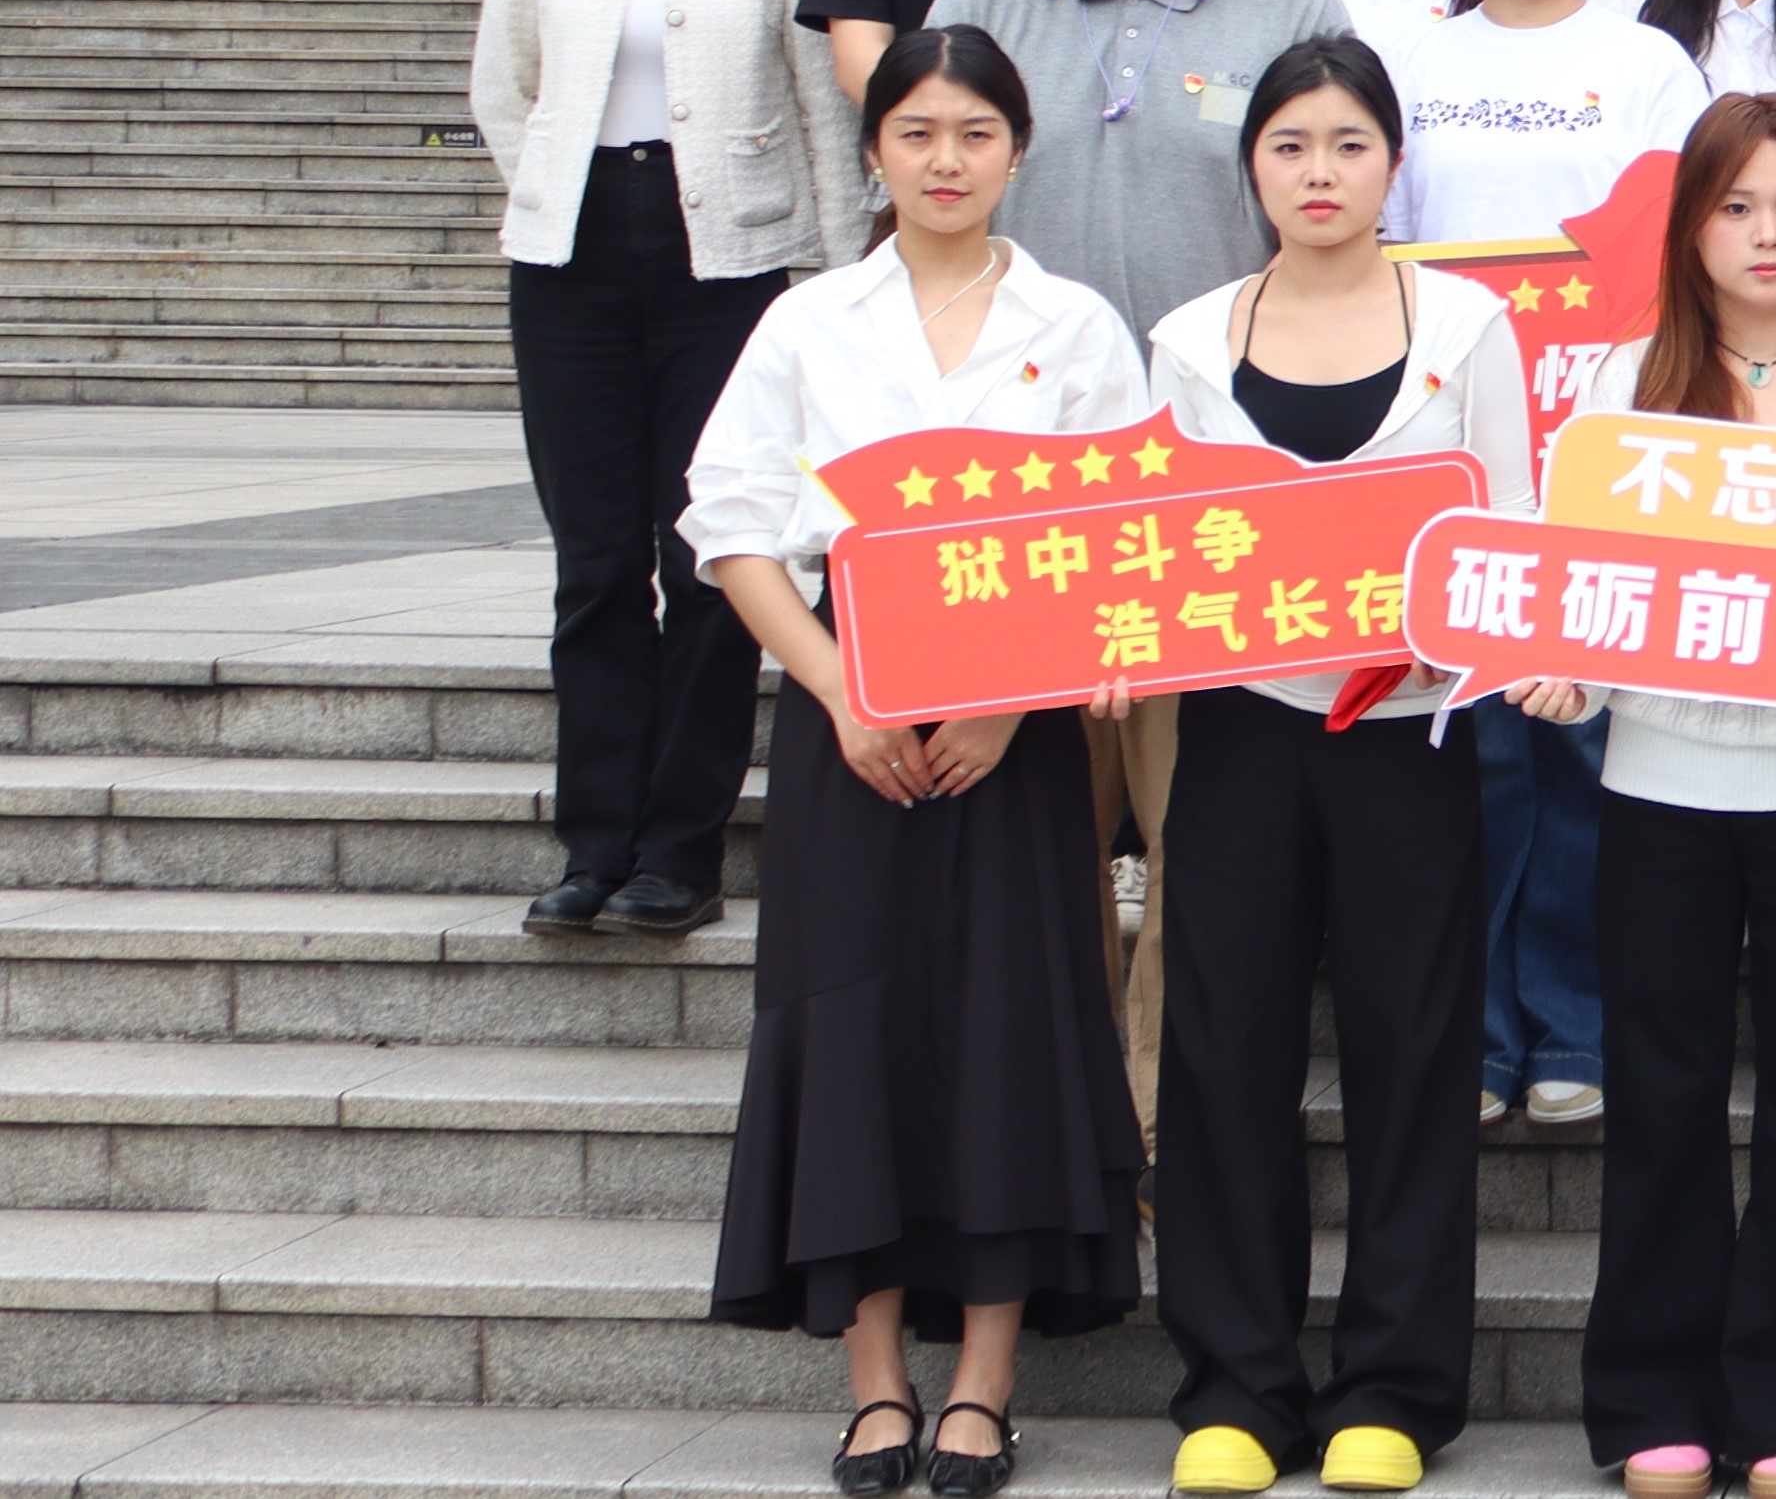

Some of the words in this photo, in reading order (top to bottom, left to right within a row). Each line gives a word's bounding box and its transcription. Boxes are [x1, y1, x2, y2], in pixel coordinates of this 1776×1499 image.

[936, 506, 1261, 606] 狱中斗争
[1093, 568, 1405, 668] 浩气长存
